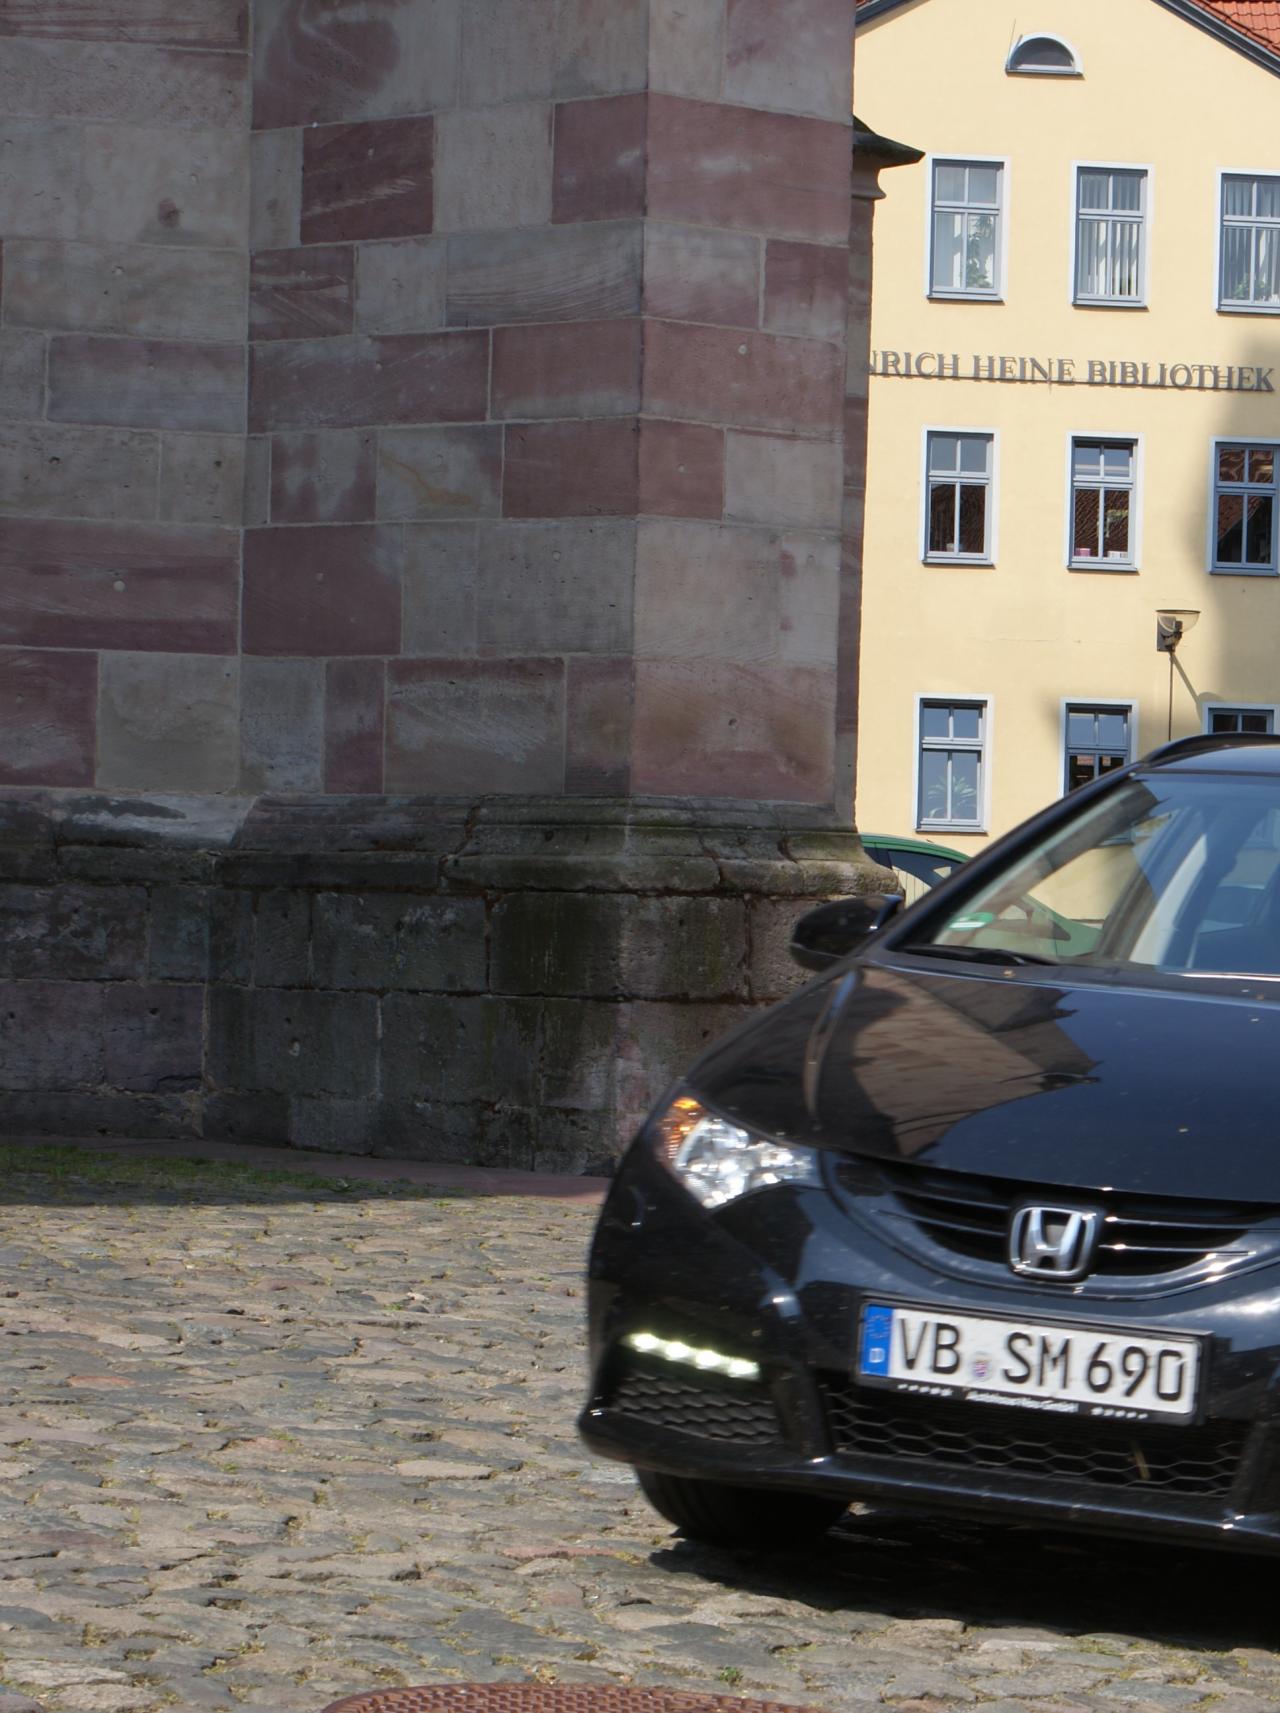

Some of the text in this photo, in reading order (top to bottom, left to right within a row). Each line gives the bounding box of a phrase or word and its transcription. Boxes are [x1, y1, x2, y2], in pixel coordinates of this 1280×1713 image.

[973, 355, 1075, 384] HEINE
[1087, 360, 1275, 392] BIBLIOTHEK
[897, 1318, 1184, 1401] VB SM 690
